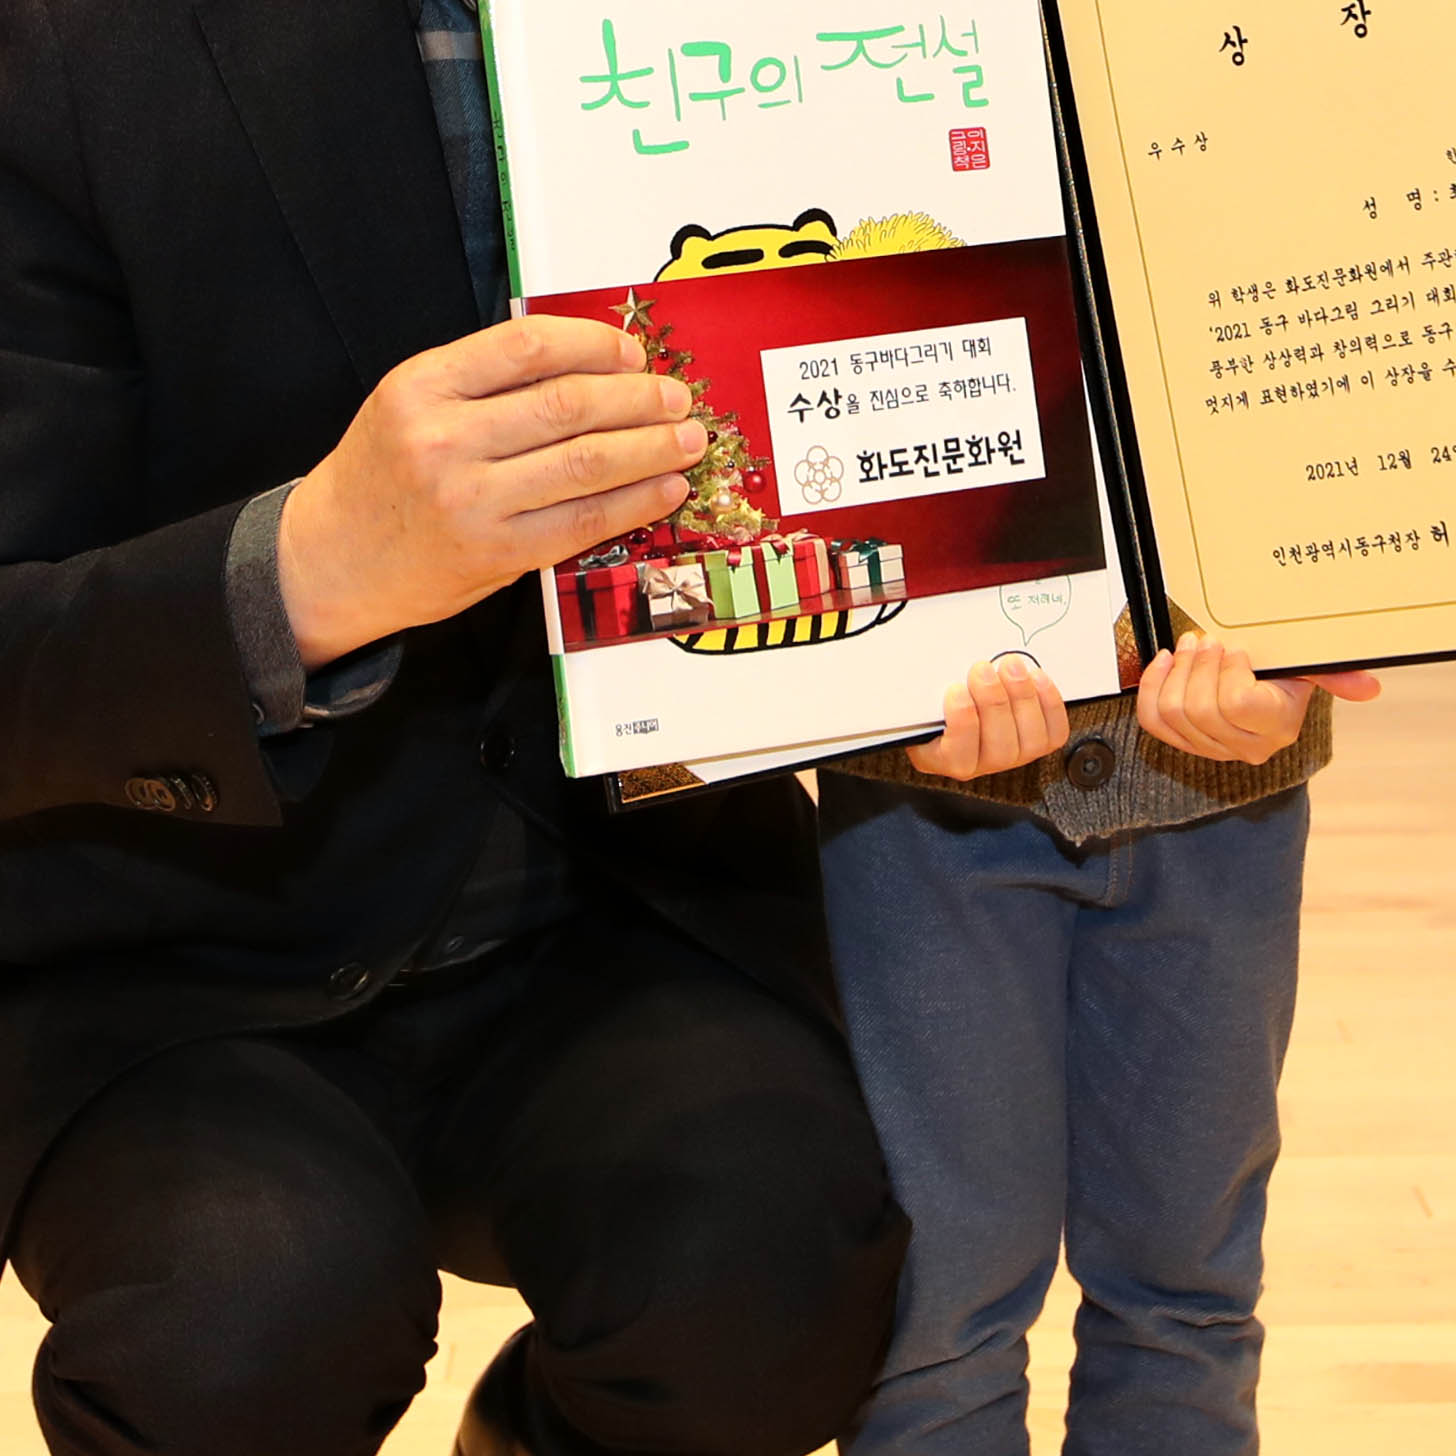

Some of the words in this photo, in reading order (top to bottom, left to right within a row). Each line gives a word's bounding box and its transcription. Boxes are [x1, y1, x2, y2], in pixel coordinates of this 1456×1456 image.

[580, 18, 803, 155] 친구의
[816, 14, 990, 108] 전설
[1207, 289, 1222, 310] 위
[1231, 280, 1277, 305] 학생은
[1284, 255, 1411, 295] 화도진문화원에서
[1259, 314, 1290, 336] 동구
[1297, 300, 1359, 329] 바다그림
[1370, 290, 1416, 316] 그리기
[799, 357, 841, 381] 2021
[849, 340, 955, 375] 동구바다그리기
[962, 336, 992, 360] 대회
[1209, 354, 1254, 380] 풍부한
[1263, 342, 1325, 371] 상상력과
[1333, 330, 1413, 360] 창의력으로
[1421, 321, 1454, 345] 동구
[787, 387, 861, 424] 수상을
[869, 383, 930, 412] 진심으로
[938, 372, 1017, 401] 축하합니다.
[1205, 390, 1250, 416] 멋지게
[1259, 374, 1351, 405] 표현하였기에
[1360, 370, 1375, 391] 이
[1384, 361, 1433, 387] 상장을
[856, 429, 1026, 484] 화도진문화원
[1304, 457, 1360, 482] 2021년
[1377, 449, 1413, 472] 12월
[1272, 529, 1422, 568] 인천광역시동구청장
